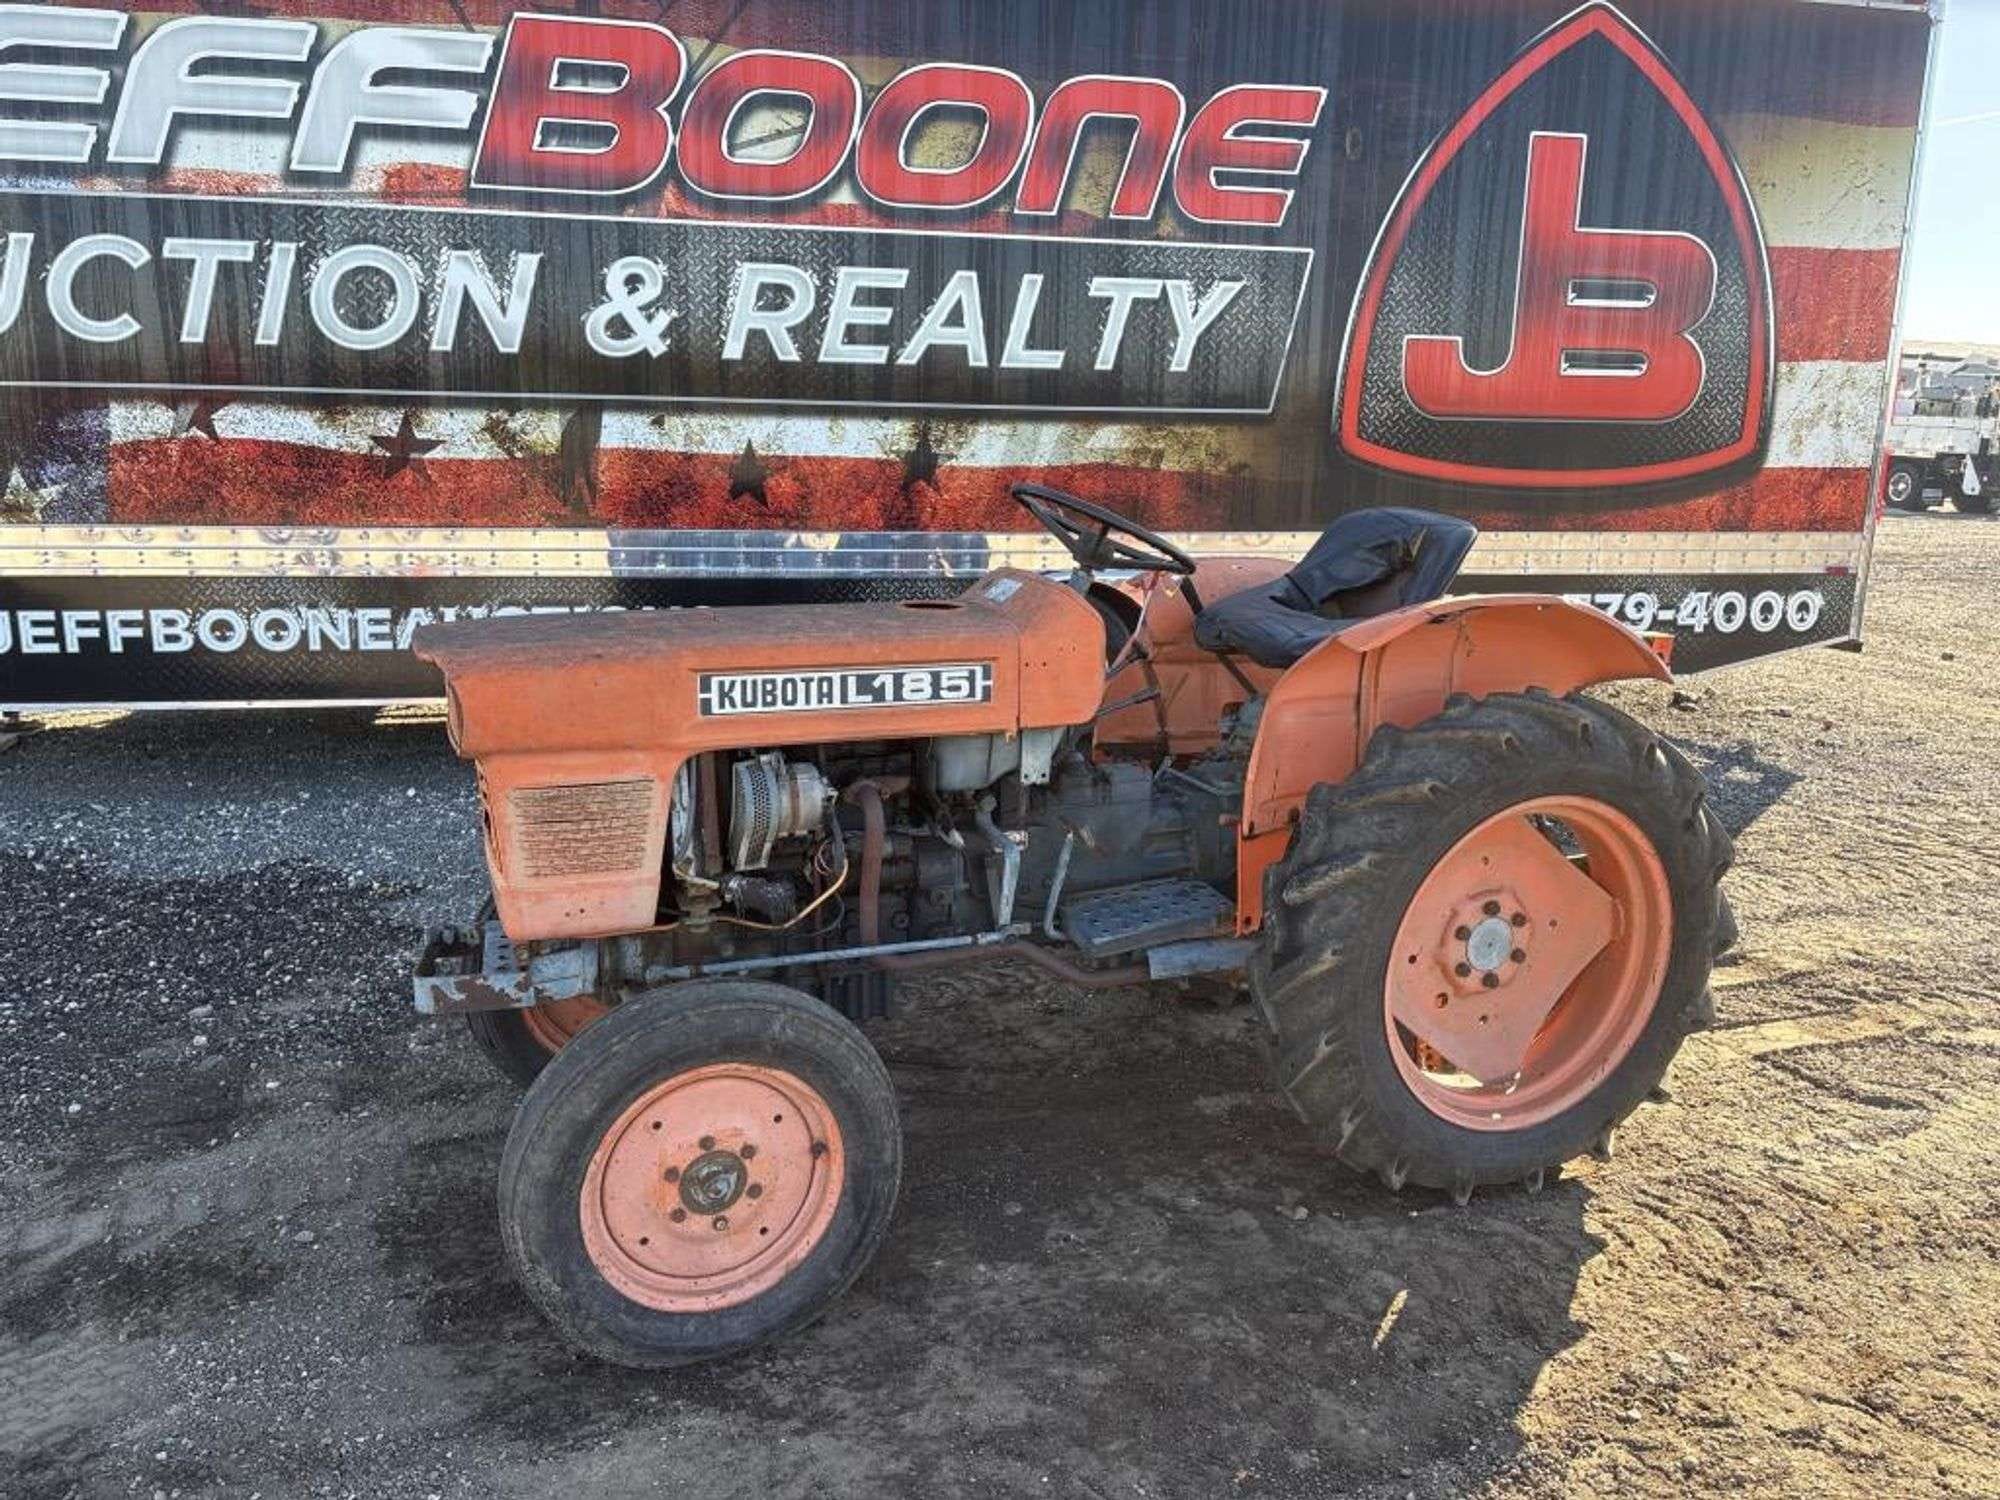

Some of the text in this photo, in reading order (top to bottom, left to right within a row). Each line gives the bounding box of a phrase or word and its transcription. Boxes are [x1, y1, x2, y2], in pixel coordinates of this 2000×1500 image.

[585, 256, 672, 360] &
[721, 262, 1246, 372] REALTY
[1562, 590, 1824, 633] 79-4000
[717, 670, 970, 710] KUBOTA L185
